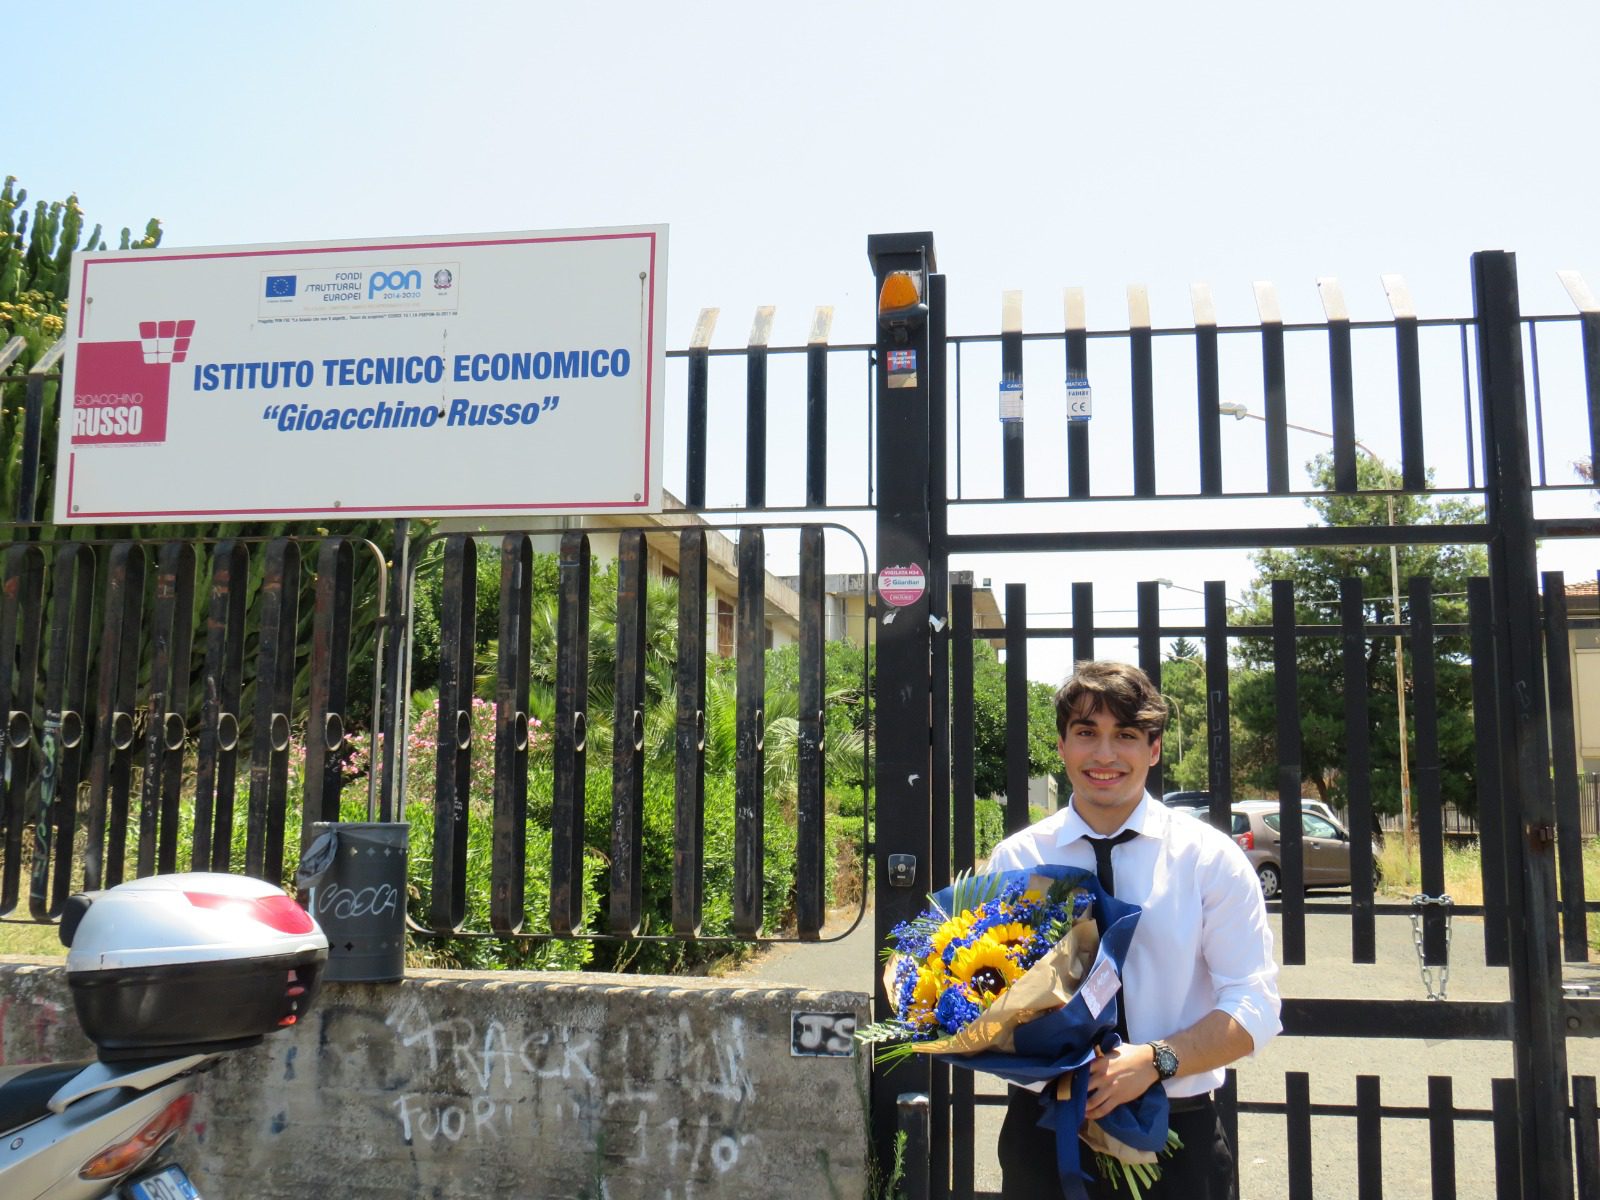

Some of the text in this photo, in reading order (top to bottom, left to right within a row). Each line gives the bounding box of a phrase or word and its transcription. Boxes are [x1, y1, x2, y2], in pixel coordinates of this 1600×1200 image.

[335, 271, 362, 281] FONDI
[304, 282, 362, 293] STRUTTURALI
[368, 269, 421, 299] pon
[323, 292, 361, 302] EUROPEI
[383, 291, 421, 300] 2014-2020
[194, 349, 630, 391] ISTITUTO TECNICO ECONOMICO
[72, 405, 143, 436] RUSSO
